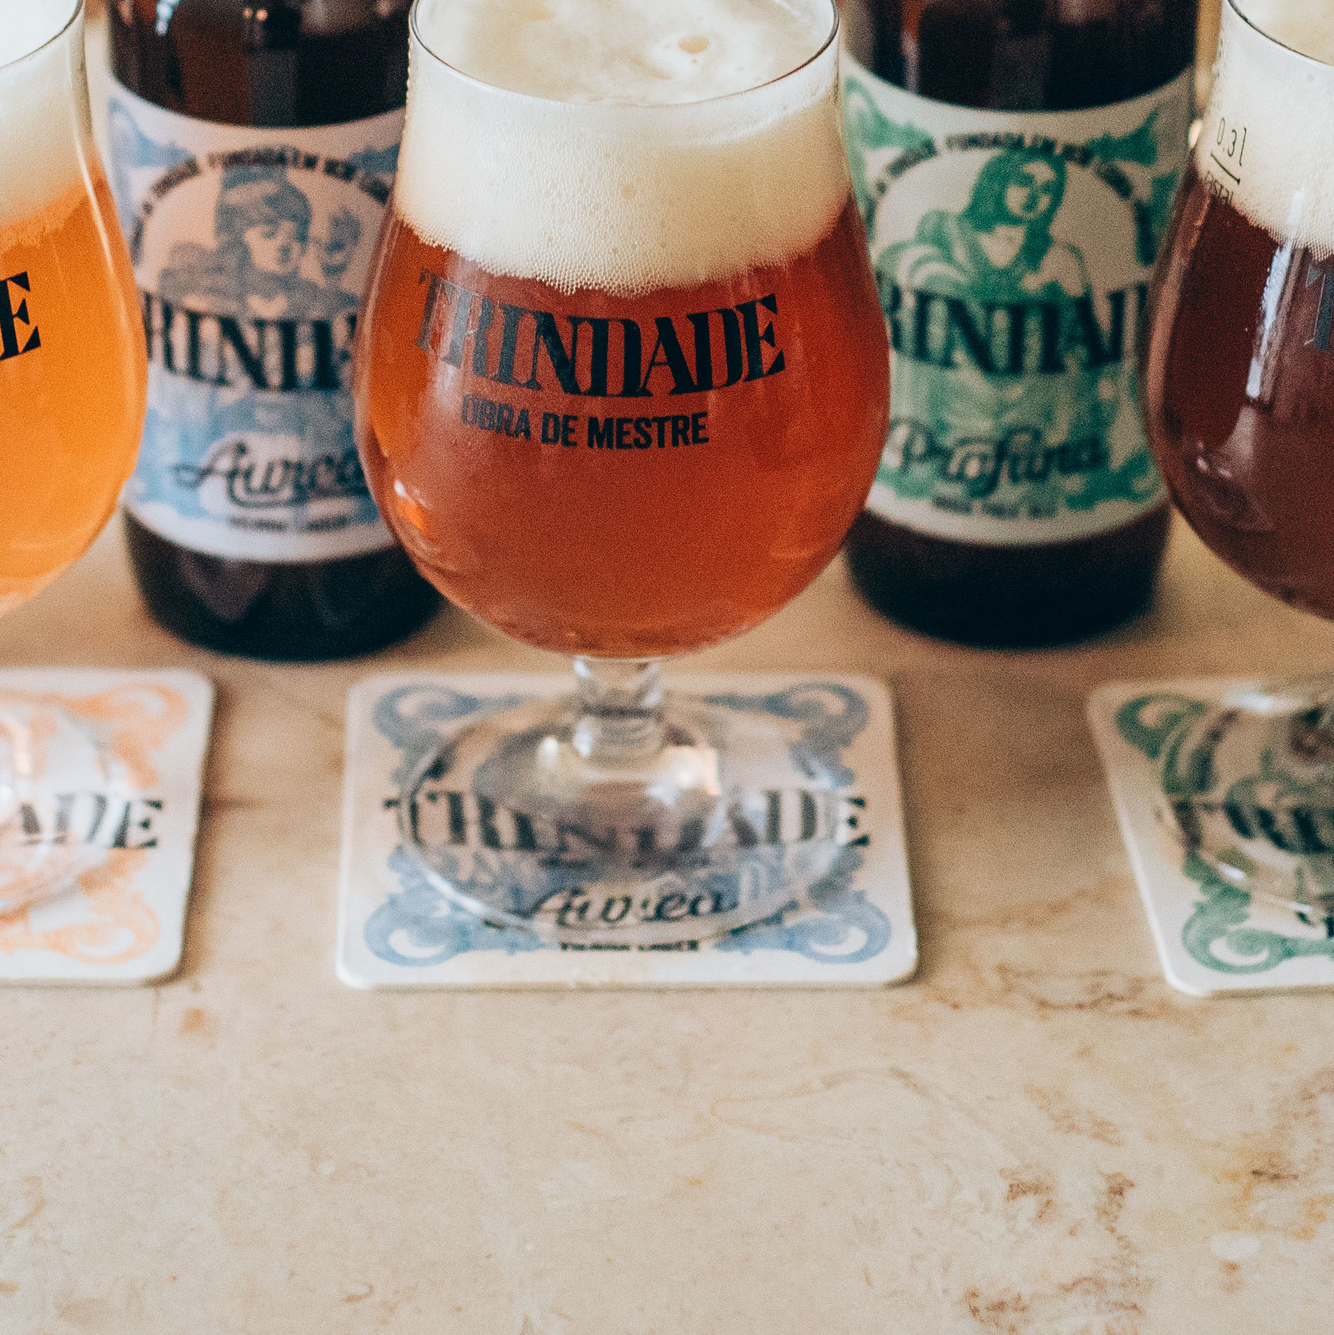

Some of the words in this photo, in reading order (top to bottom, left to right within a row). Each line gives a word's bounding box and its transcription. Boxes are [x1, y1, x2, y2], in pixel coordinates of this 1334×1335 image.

[413, 266, 786, 397] TRINDADE
[461, 394, 532, 440] OBRA
[541, 412, 578, 447] DE
[587, 411, 710, 451] MESTRE
